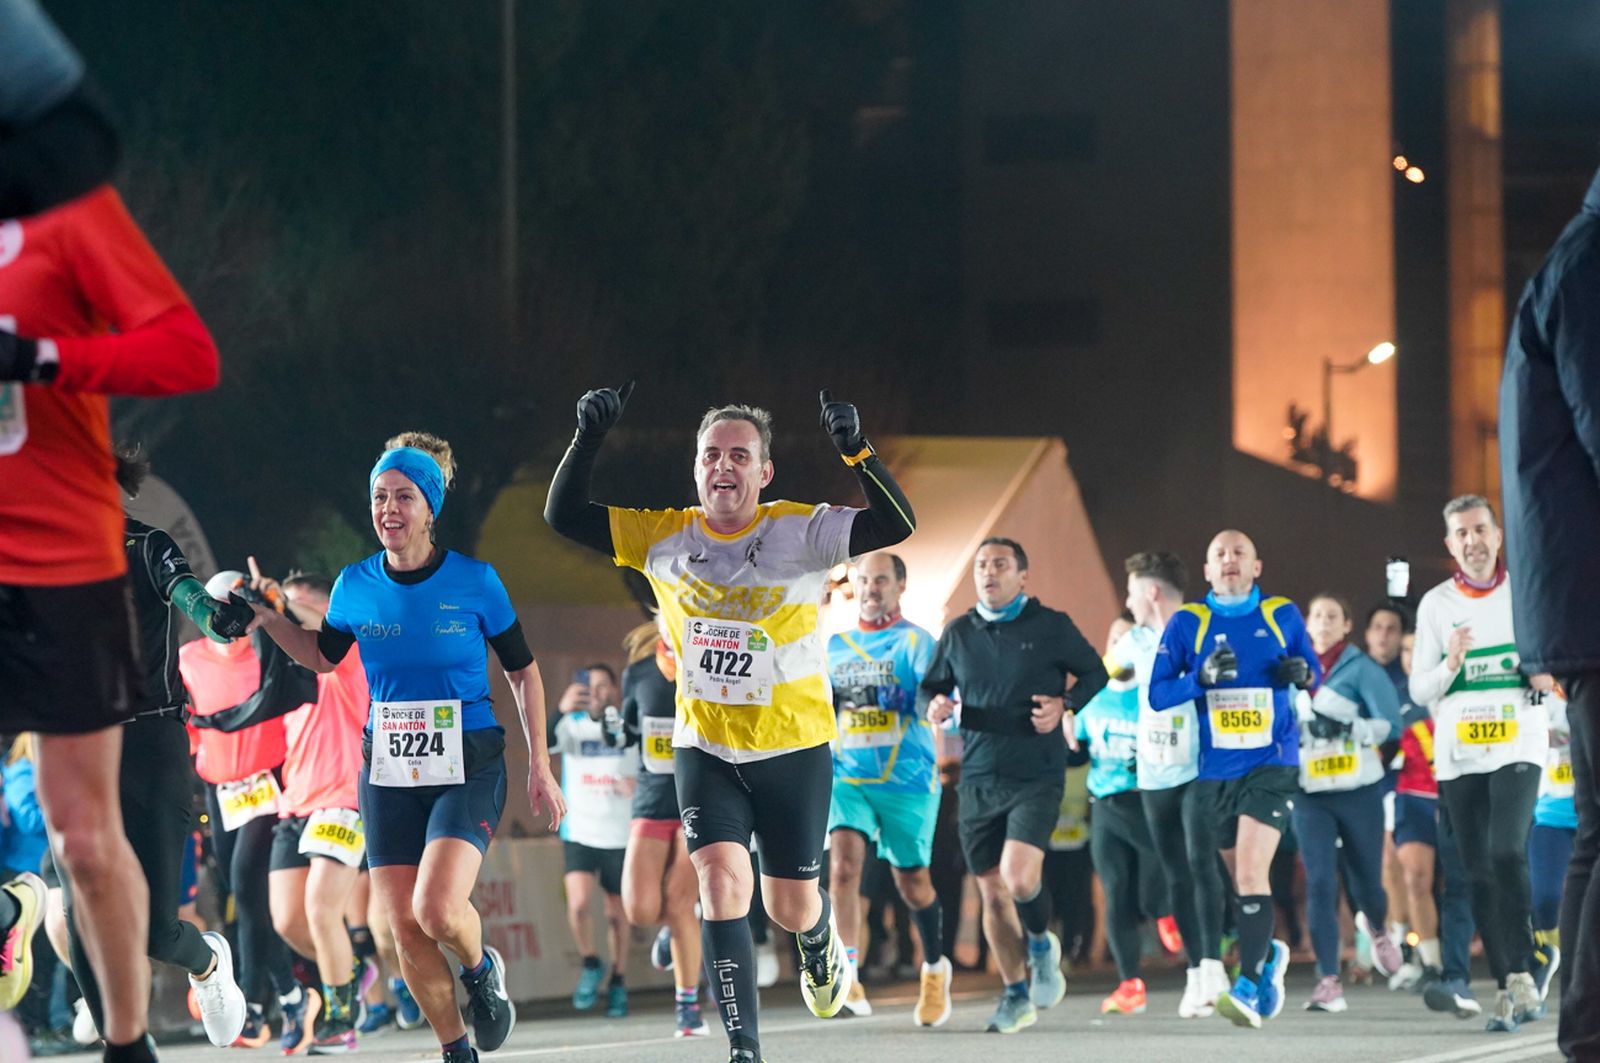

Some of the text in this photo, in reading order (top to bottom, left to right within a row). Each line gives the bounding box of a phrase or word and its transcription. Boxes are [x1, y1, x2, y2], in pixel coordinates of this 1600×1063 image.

[692, 636, 709, 647] SAN
[729, 630, 740, 639] DE
[700, 649, 753, 677] 4722
[391, 710, 426, 720] NOCHE DE
[1221, 711, 1262, 728] 8563
[382, 721, 397, 730] SAN
[398, 720, 426, 731] ANTÓN
[1469, 722, 1507, 739] 3121
[389, 731, 445, 758] 5224
[316, 824, 356, 845] 5808
[713, 959, 742, 1031] kalenji
